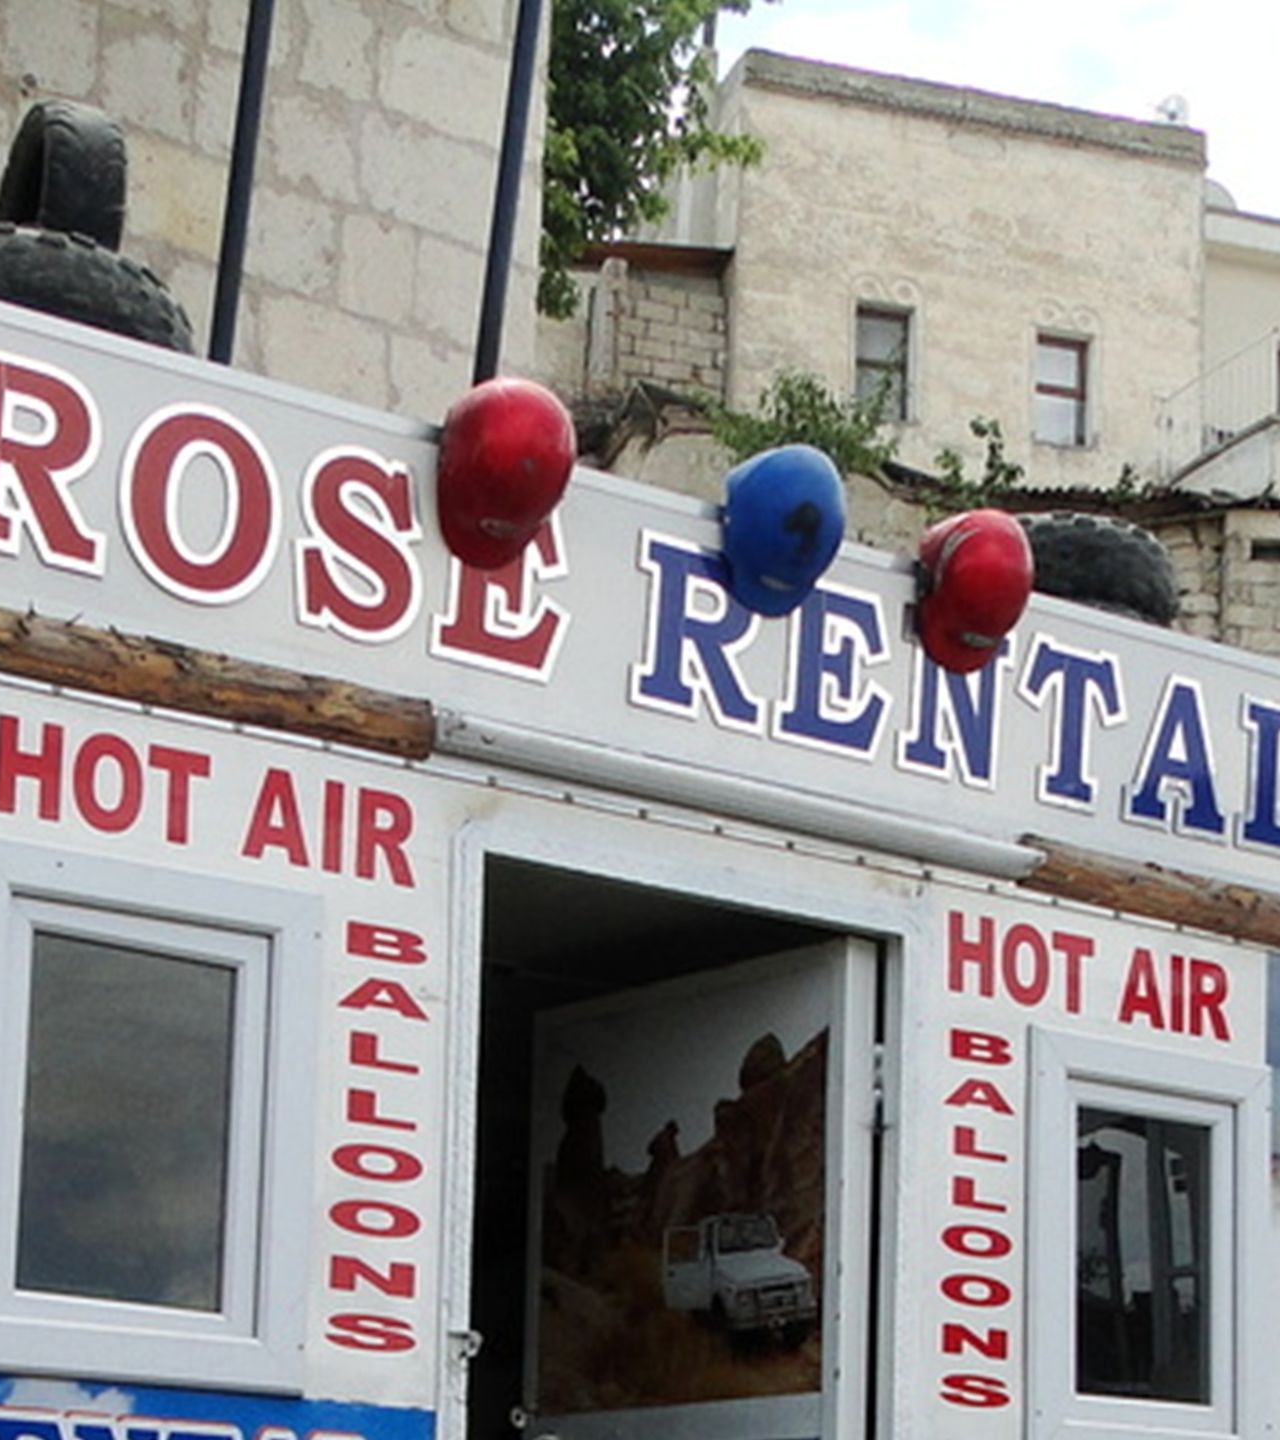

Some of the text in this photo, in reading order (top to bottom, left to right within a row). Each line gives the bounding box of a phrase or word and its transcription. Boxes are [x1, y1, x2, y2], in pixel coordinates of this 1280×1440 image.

[241, 767, 416, 888] AIR
[947, 910, 1231, 1042] HOT AIR
[325, 921, 430, 1353] BALLOONS
[940, 1028, 1014, 1409] BALLOONS
